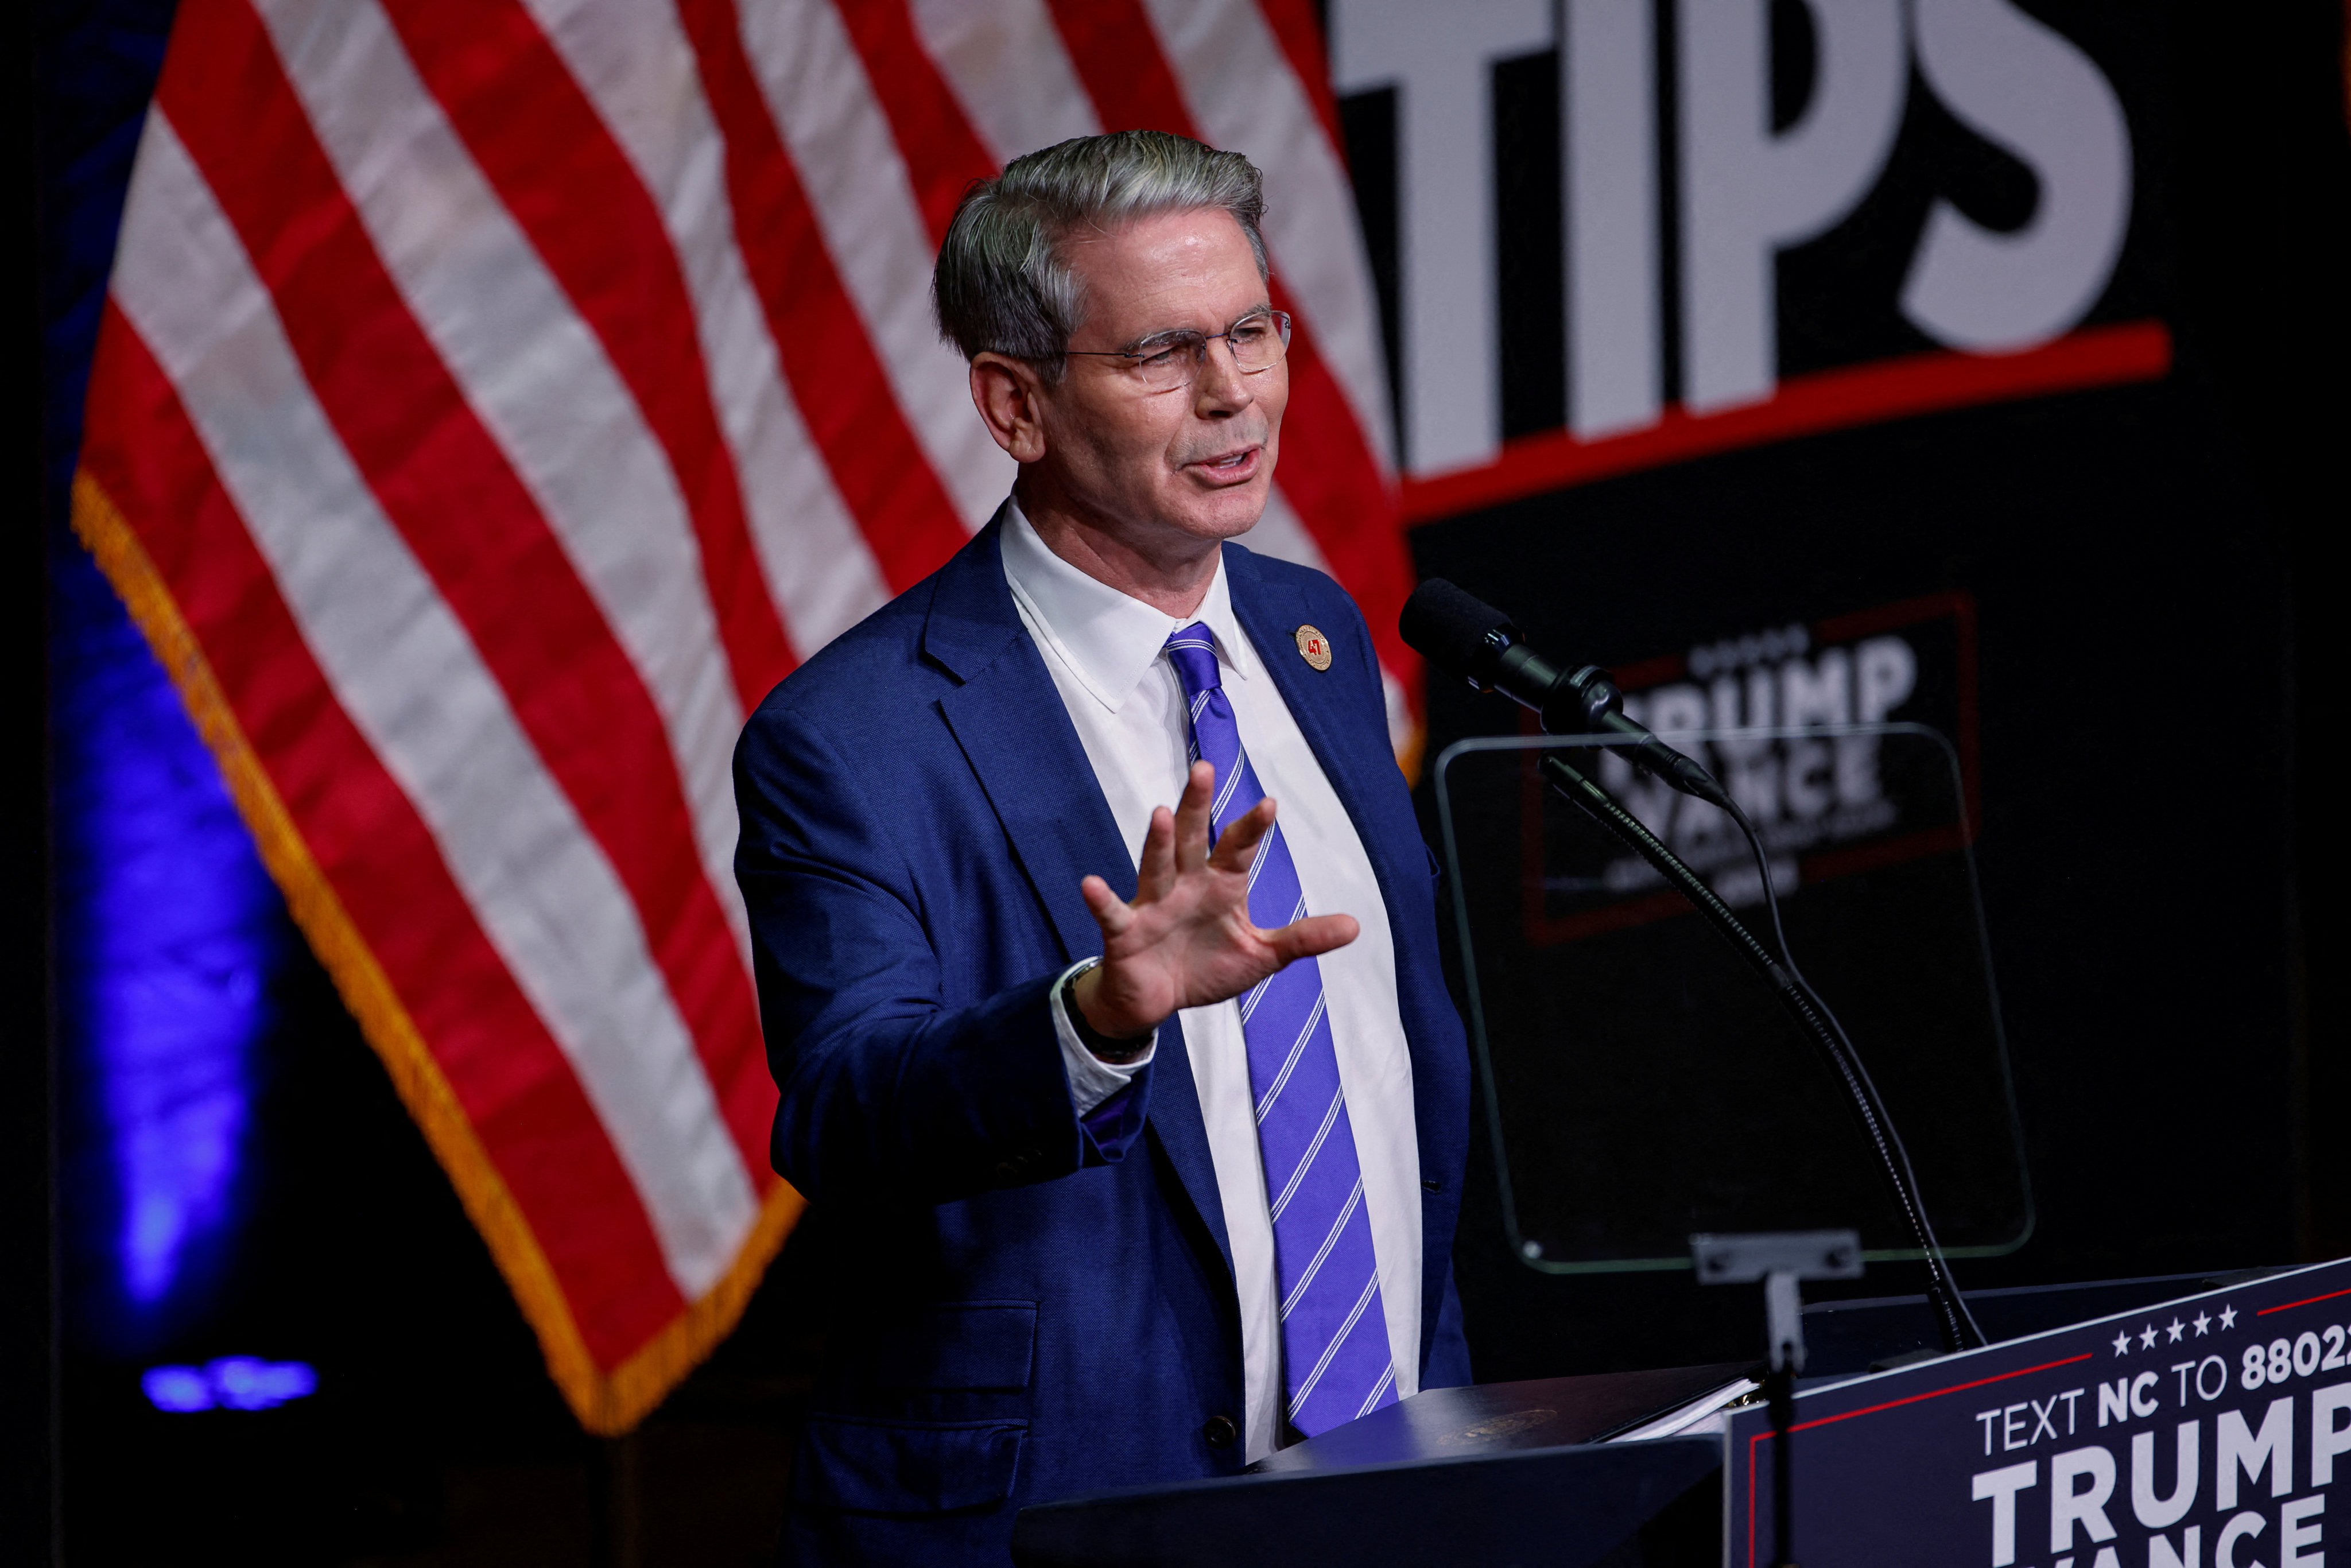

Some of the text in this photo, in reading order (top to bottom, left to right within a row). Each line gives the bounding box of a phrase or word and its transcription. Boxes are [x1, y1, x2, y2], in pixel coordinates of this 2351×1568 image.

[1333, 0, 2134, 483] TIPS
[1619, 633, 1918, 783] RUMP
[1976, 1323, 2351, 1456] TEXT NC TO 8802
[1972, 1382, 2351, 1568] TRUMP
